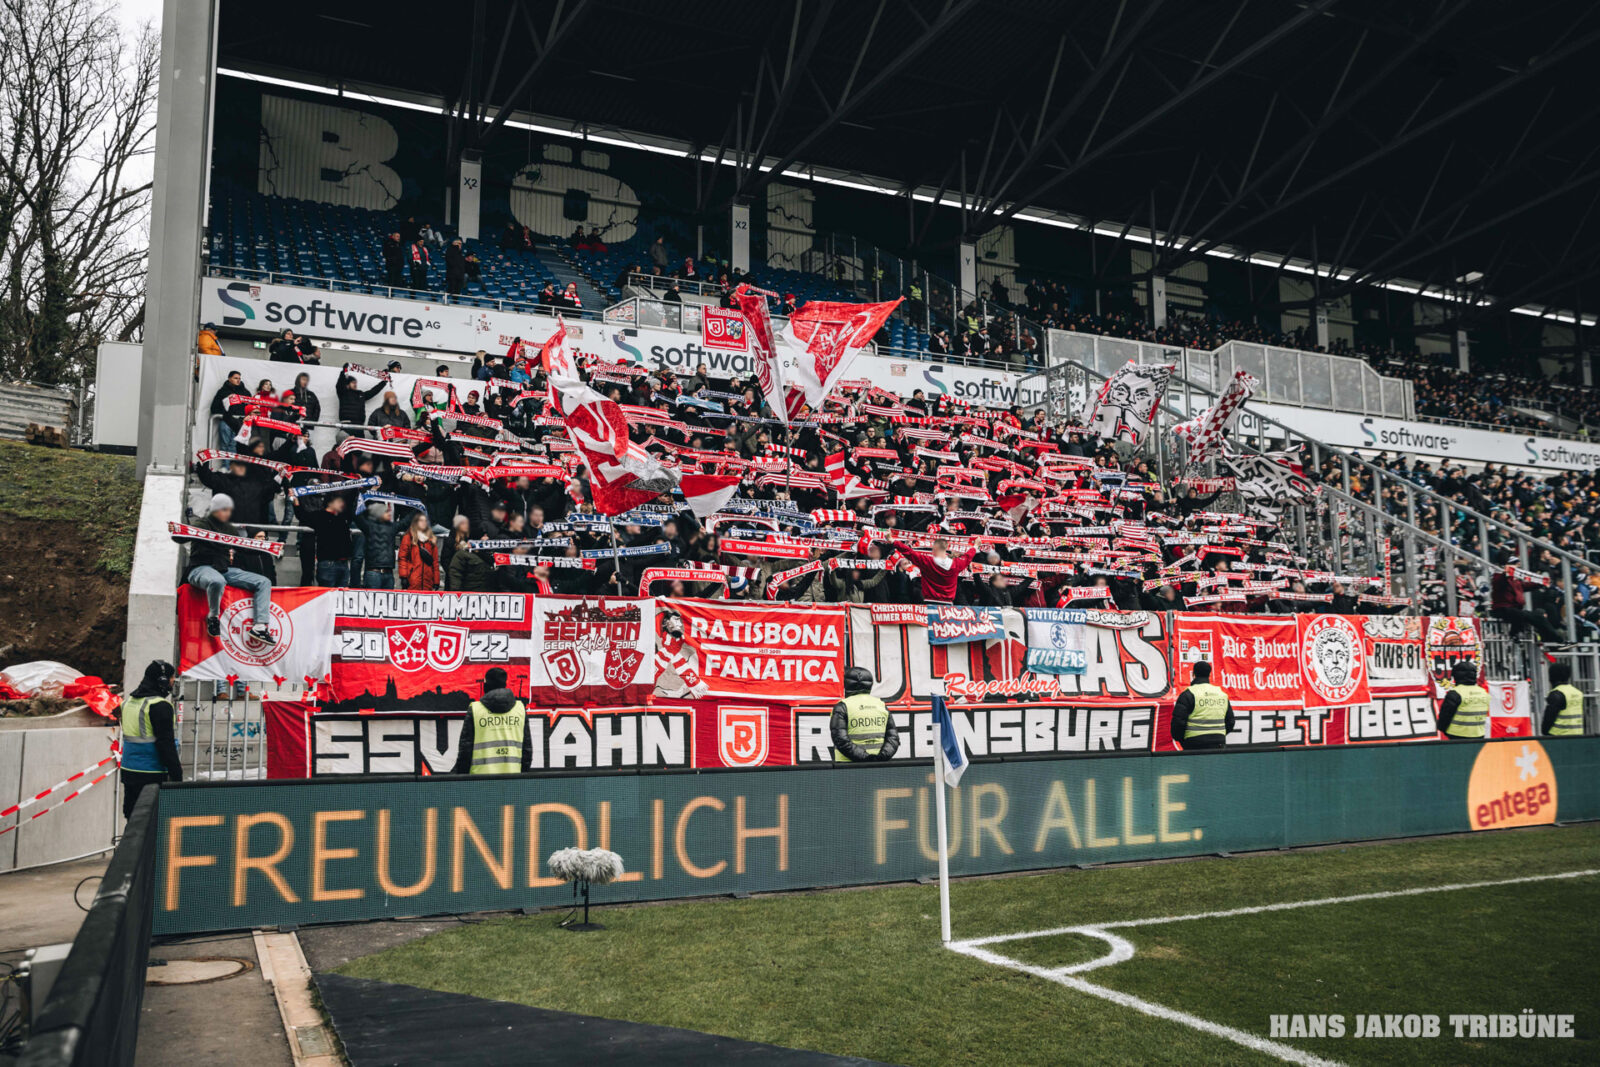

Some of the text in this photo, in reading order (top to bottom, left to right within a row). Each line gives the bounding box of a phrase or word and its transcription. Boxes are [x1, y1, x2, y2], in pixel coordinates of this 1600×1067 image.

[265, 299, 441, 338] software AG
[1380, 427, 1449, 450] software
[1541, 446, 1600, 467] software
[761, 546, 796, 555] REGENSBURG
[667, 570, 690, 578] JAKOB
[693, 571, 727, 582] TRIBÜNE
[769, 575, 784, 591] NUR
[787, 568, 801, 578] DER
[872, 603, 929, 615] CHRISTOPH FÜR
[872, 612, 901, 622] IMMER
[902, 613, 914, 622] BEI
[1027, 609, 1087, 624] STUTTGARTER
[690, 615, 841, 648] RATISBONA
[341, 631, 510, 662] 20 22
[615, 640, 638, 650] 2019
[1220, 634, 1299, 663] Die Power
[704, 652, 841, 684] FANATICA
[1027, 648, 1087, 669] KICKERS
[943, 671, 1061, 701] Regensburg
[1253, 667, 1300, 690] Tower
[1198, 698, 1226, 708] ORDNER
[478, 715, 521, 729] ORDNER
[850, 716, 886, 729] ORDNER
[1350, 696, 1438, 740] 1889
[495, 747, 509, 756] 452
[1476, 780, 1551, 827] entega
[163, 774, 1205, 912] FREUNDLICH FÜR ALLE.
